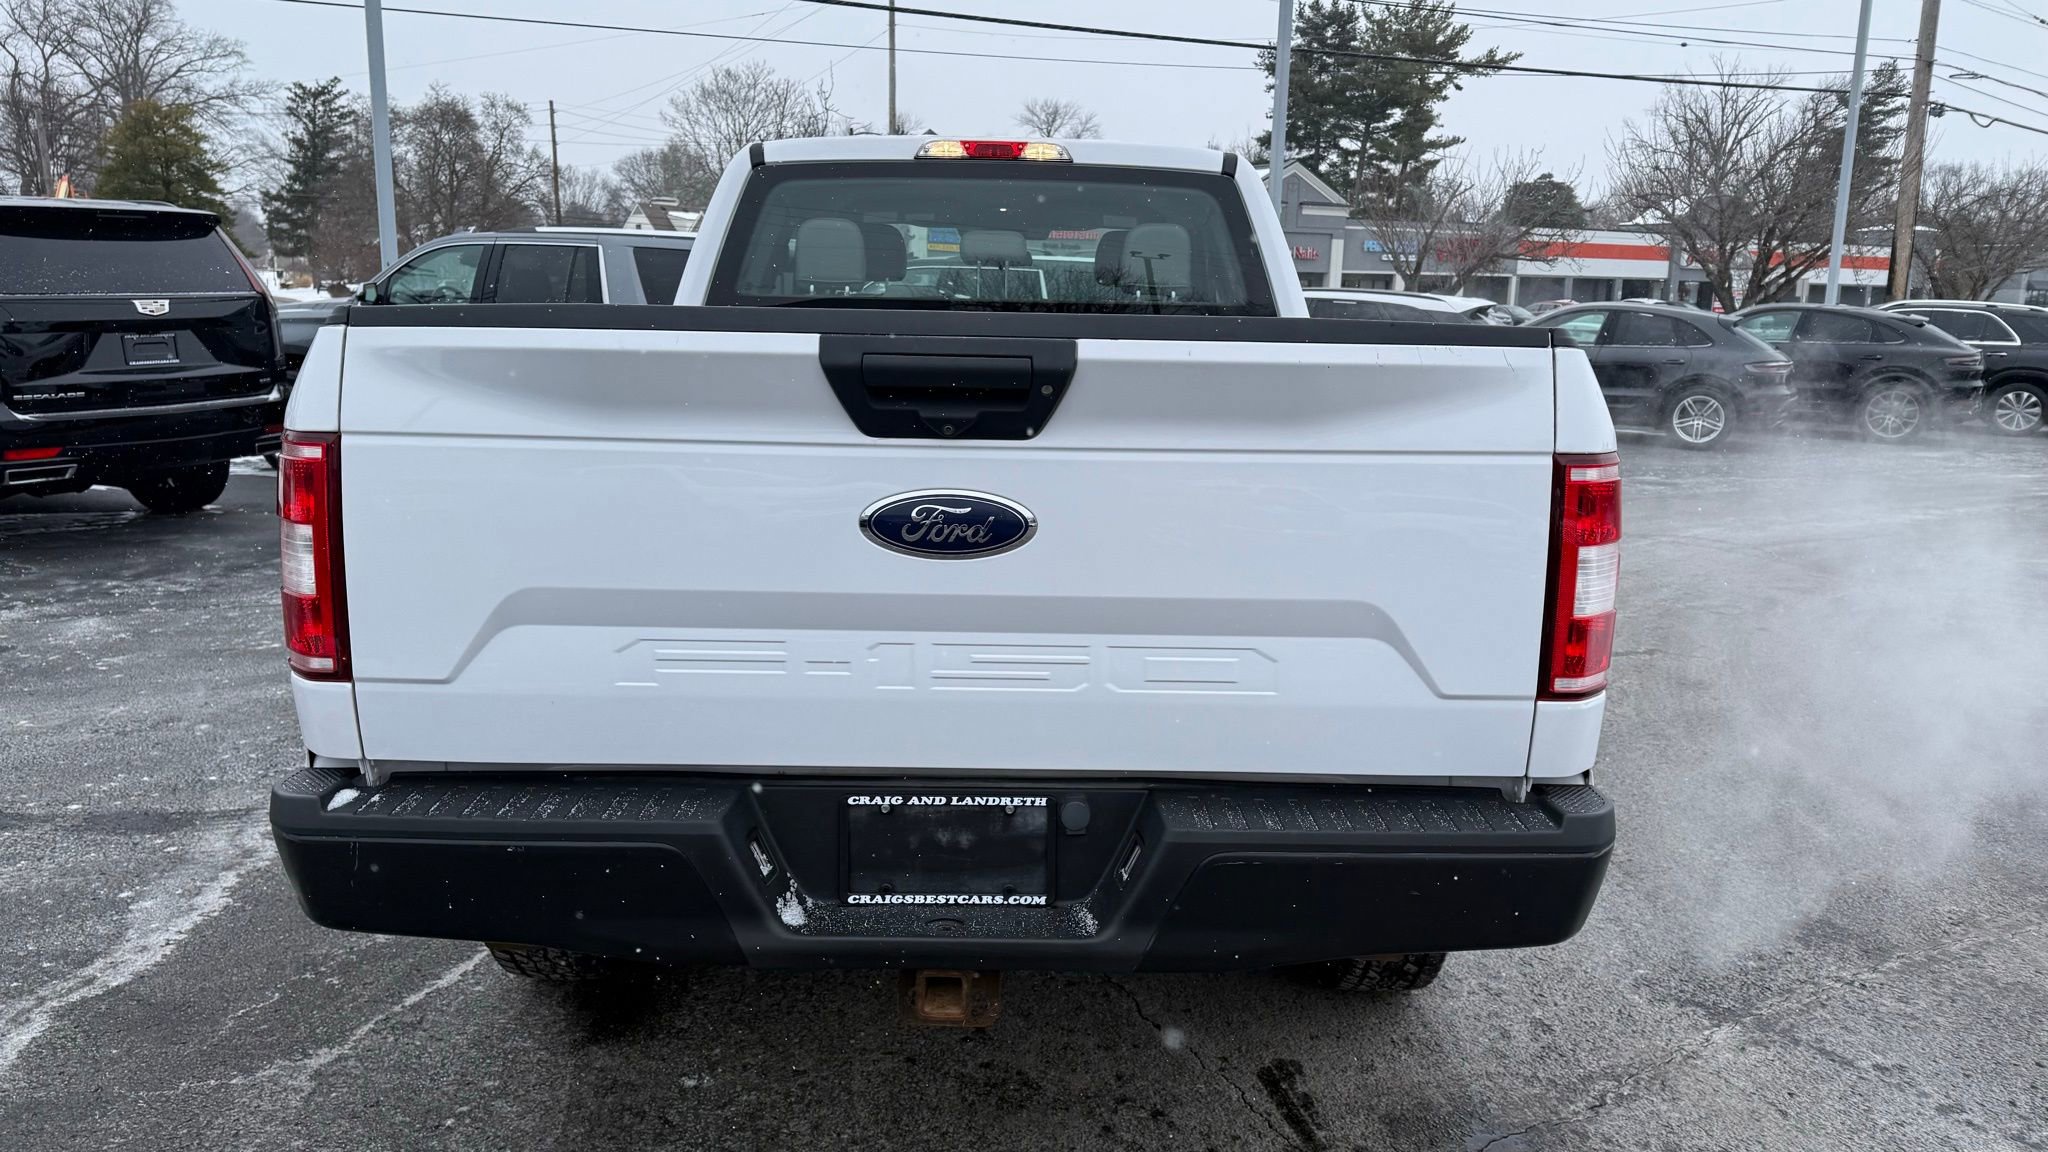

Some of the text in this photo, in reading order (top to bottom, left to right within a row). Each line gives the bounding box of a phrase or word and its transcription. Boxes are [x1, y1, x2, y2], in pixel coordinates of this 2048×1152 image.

[901, 504, 995, 544] Ford
[614, 638, 1279, 696] F-150
[847, 796, 1048, 806] CRAIG AND LANDRETH
[847, 894, 1047, 905] CRAIGSBESTCARS.COM
